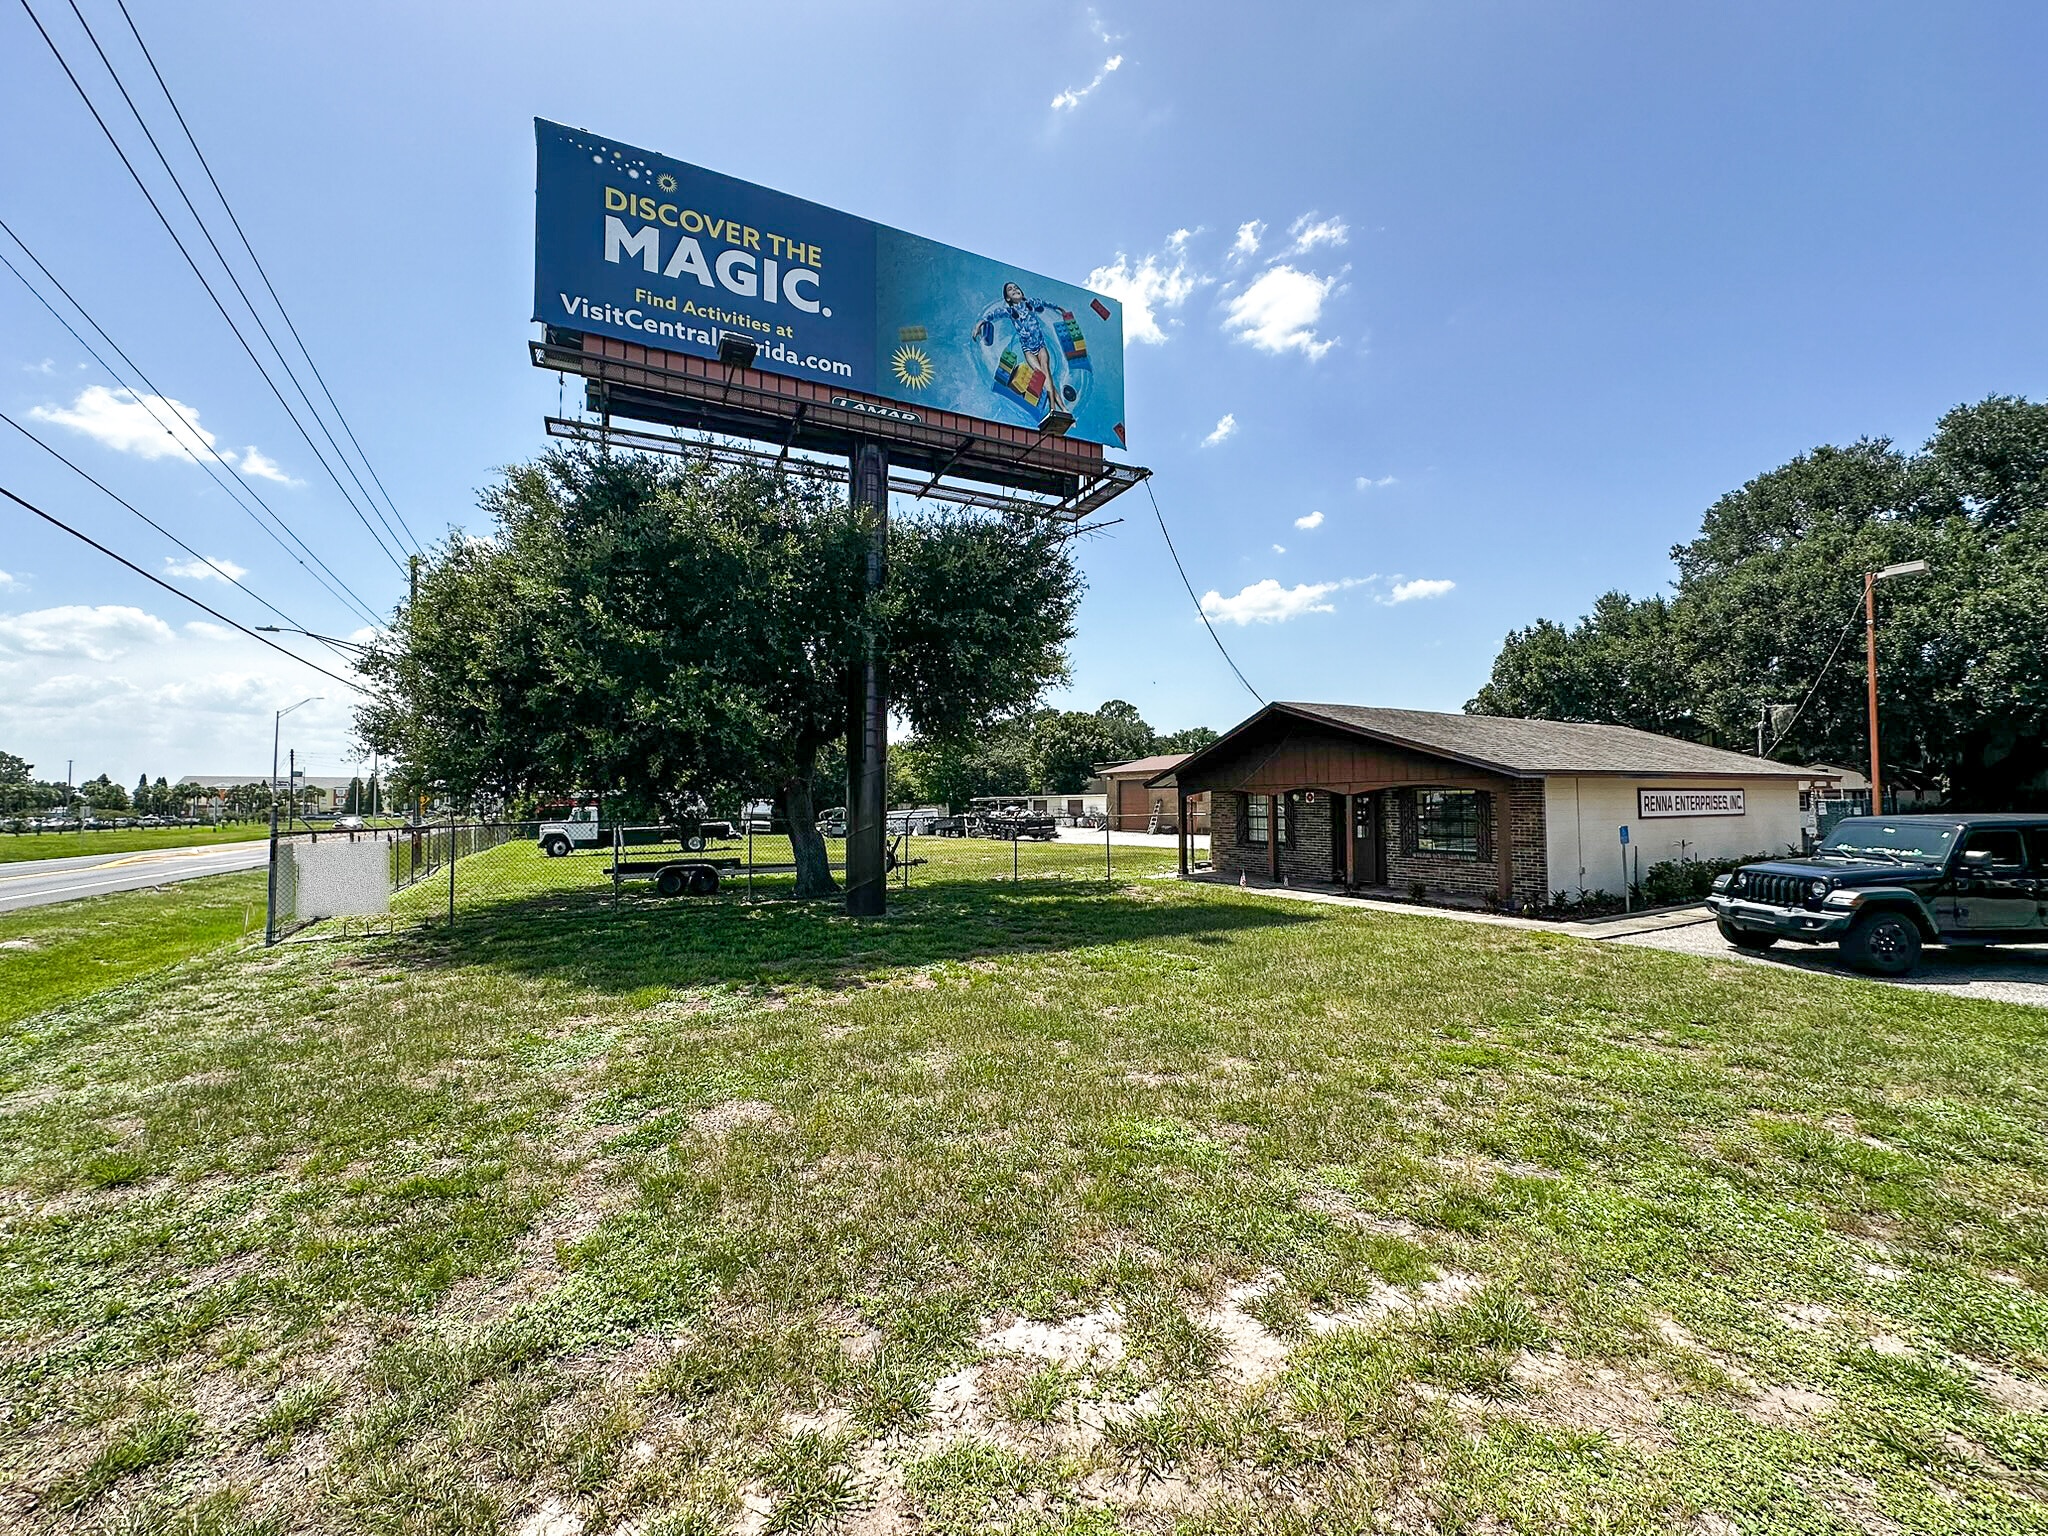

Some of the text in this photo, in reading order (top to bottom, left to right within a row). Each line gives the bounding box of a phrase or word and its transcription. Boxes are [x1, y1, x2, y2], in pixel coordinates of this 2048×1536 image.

[604, 215, 833, 318] MAGIC.
[605, 187, 822, 267] DISCOVER THE
[560, 293, 852, 377] VisitCentralrida.com
[635, 288, 794, 339] Find Activities at
[1644, 795, 1673, 811] RENNA
[1675, 795, 1729, 811] ENTERPRISES,
